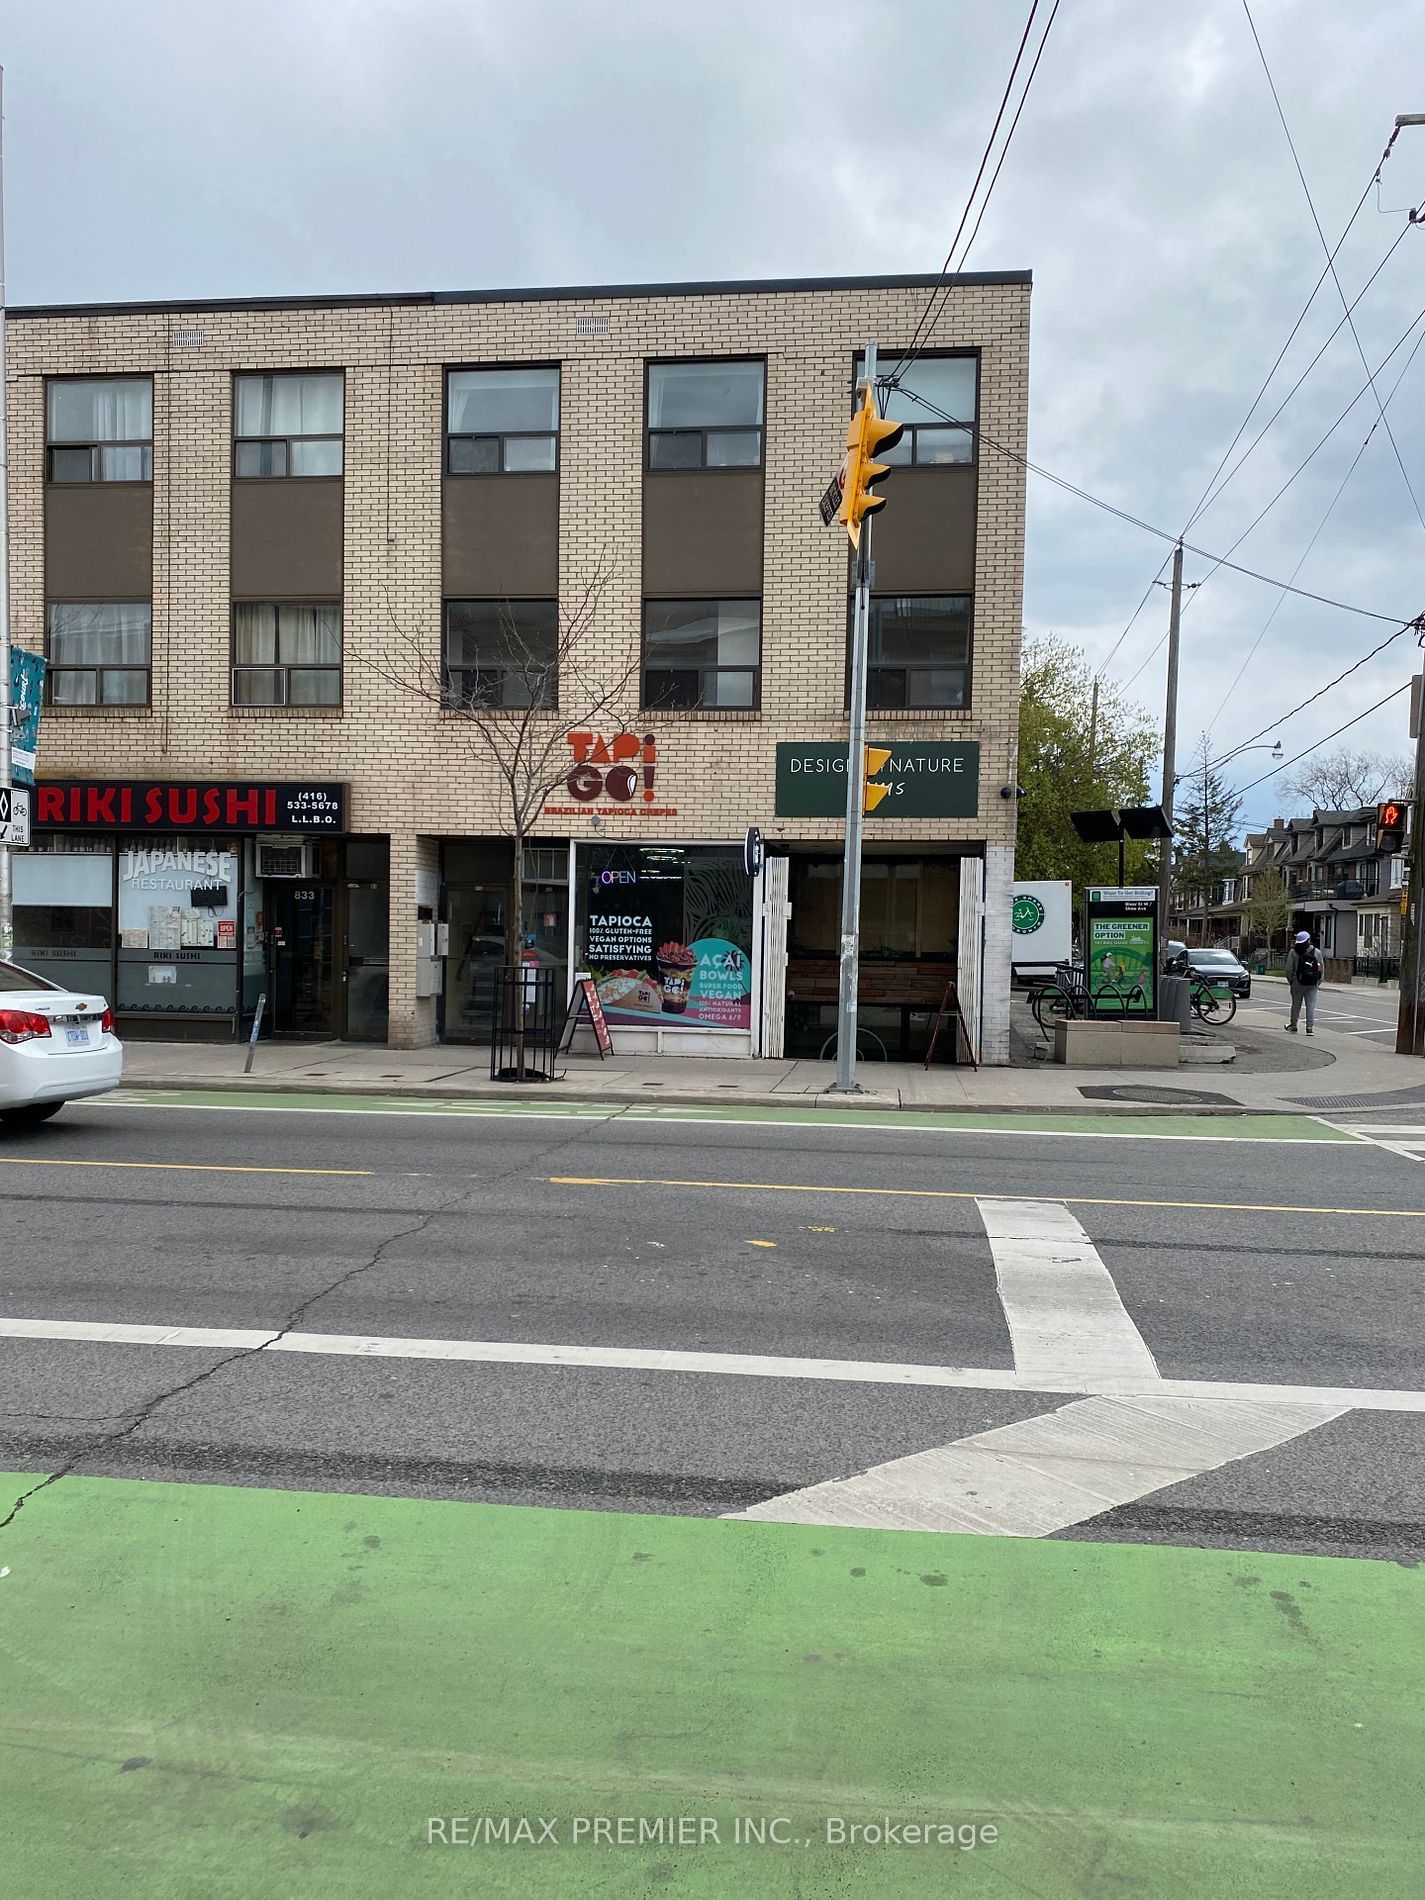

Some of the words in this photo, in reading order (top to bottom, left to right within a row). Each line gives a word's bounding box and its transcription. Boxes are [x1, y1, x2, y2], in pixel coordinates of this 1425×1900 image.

[789, 758, 849, 773] DESIG
[889, 757, 964, 773] NATURE
[566, 765, 655, 802] GO!
[298, 792, 327, 802] (416)
[37, 786, 132, 823] RIKI
[144, 786, 277, 825] SUSHI
[287, 801, 338, 810] 533-5678
[544, 807, 594, 815] BRAZILIAN
[597, 808, 637, 816] TAPIOCA
[640, 808, 678, 817] CREPES
[291, 815, 337, 824] L.L.B.O.
[12, 825, 23, 833] THIS
[11, 834, 24, 842] LANE
[122, 850, 232, 883] JAPANESE
[601, 870, 637, 885] OPEN
[131, 878, 223, 891] RESTAURANT
[294, 891, 315, 900] 833
[589, 915, 653, 927] TAPIOCA
[589, 935, 617, 943] VEGAN
[617, 936, 652, 944] OPTIONS
[31, 949, 49, 957] RIKI
[51, 949, 77, 957] SUSHI
[588, 944, 652, 954] SATISFYING
[153, 951, 172, 960] RIKI
[175, 952, 201, 960] SUSHI
[700, 970, 743, 981] BOWLS
[700, 990, 742, 1001] VEGAN
[698, 1013, 727, 1021] OMEGA
[728, 1014, 742, 1022] 6/9
